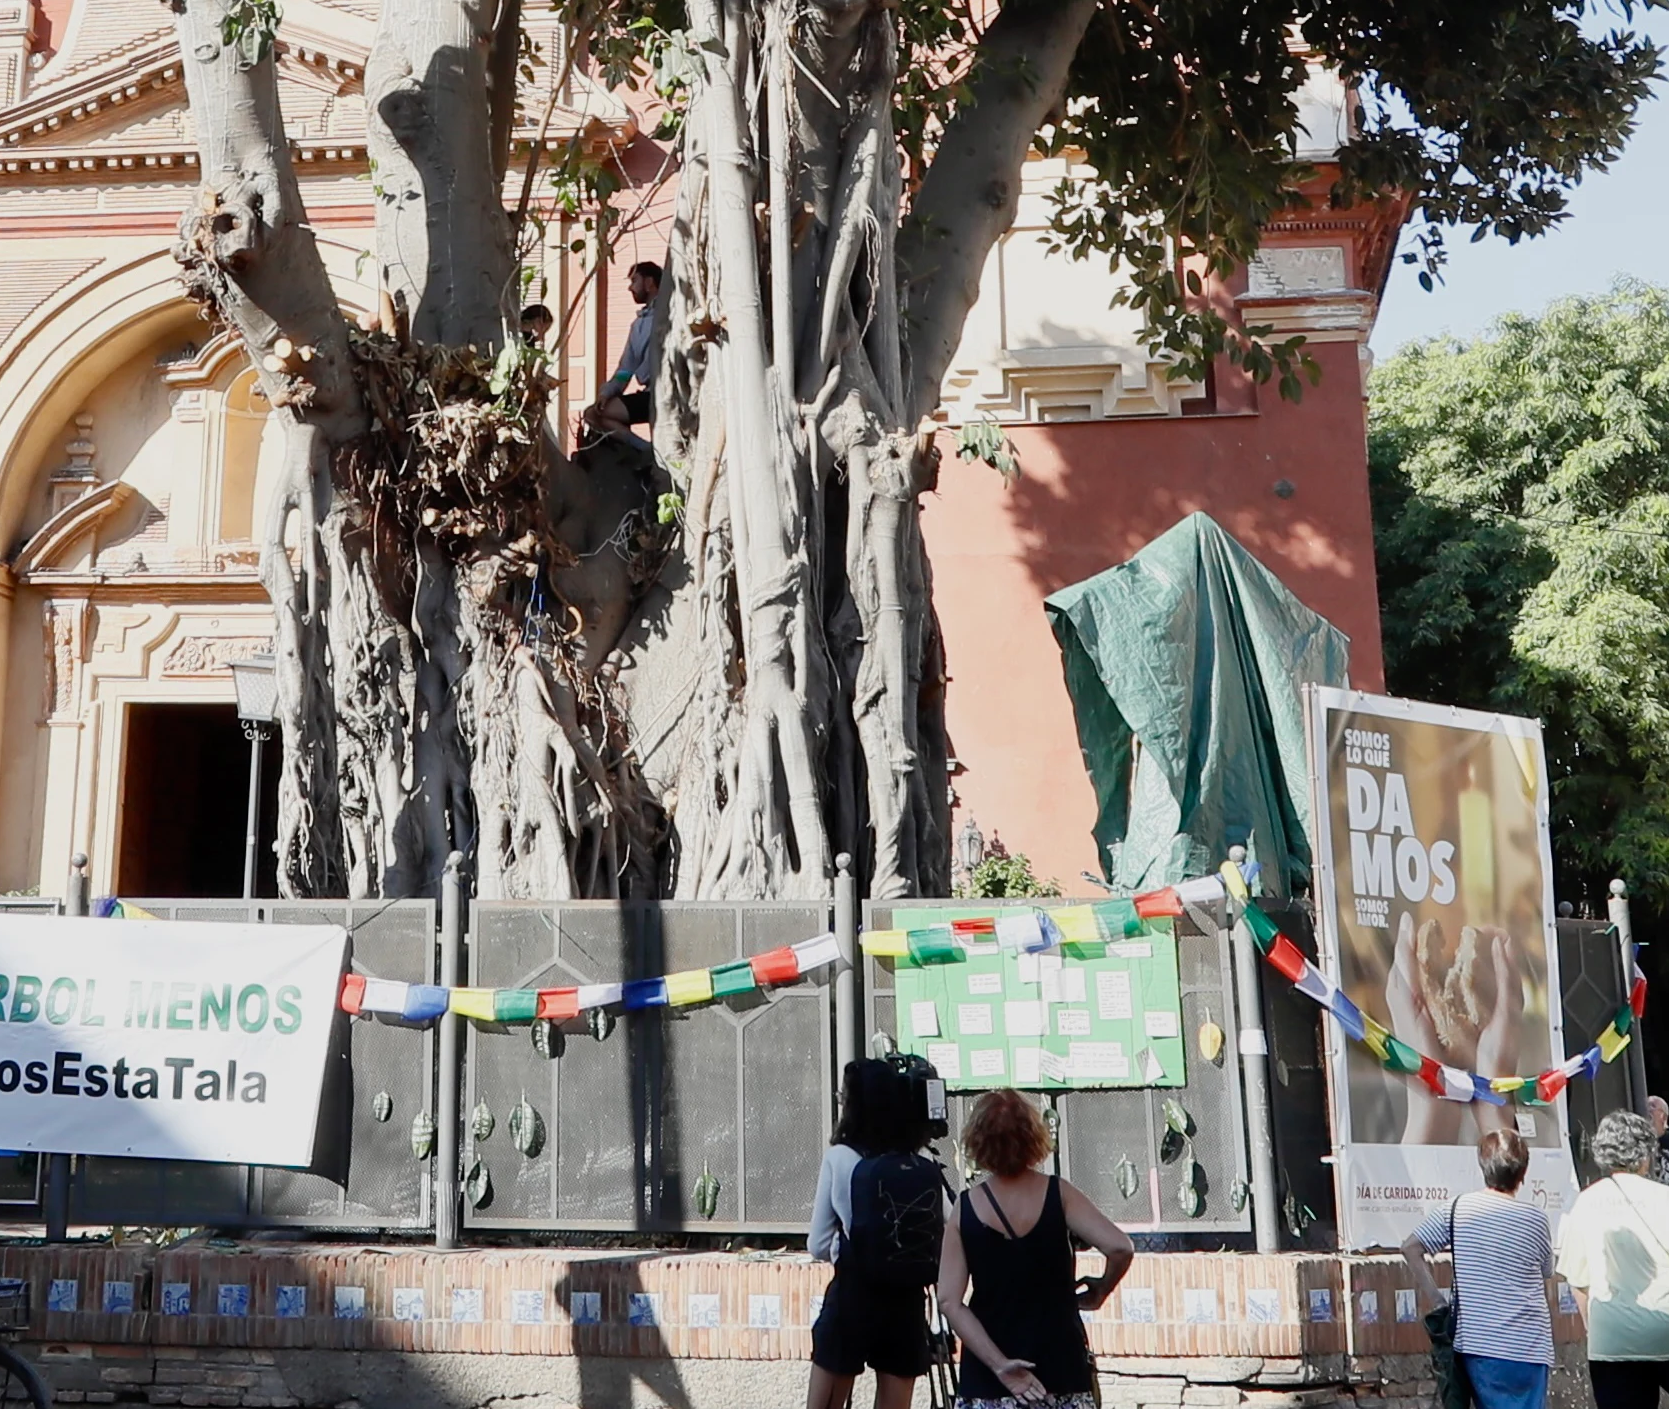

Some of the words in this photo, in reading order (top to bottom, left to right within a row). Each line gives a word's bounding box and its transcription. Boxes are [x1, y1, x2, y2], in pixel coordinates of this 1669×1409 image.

[1344, 728, 1390, 751] SOMOS
[1345, 746, 1362, 764] LO
[1363, 748, 1390, 768] QUE
[1345, 767, 1415, 837] DA
[1349, 831, 1456, 905] MOS
[1354, 897, 1389, 914] SOMOS
[1357, 911, 1389, 929] AMOR.
[124, 980, 303, 1036] MENOS
[1383, 1186, 1424, 1200] CARIDAD
[1425, 1187, 1450, 1201] 2022
